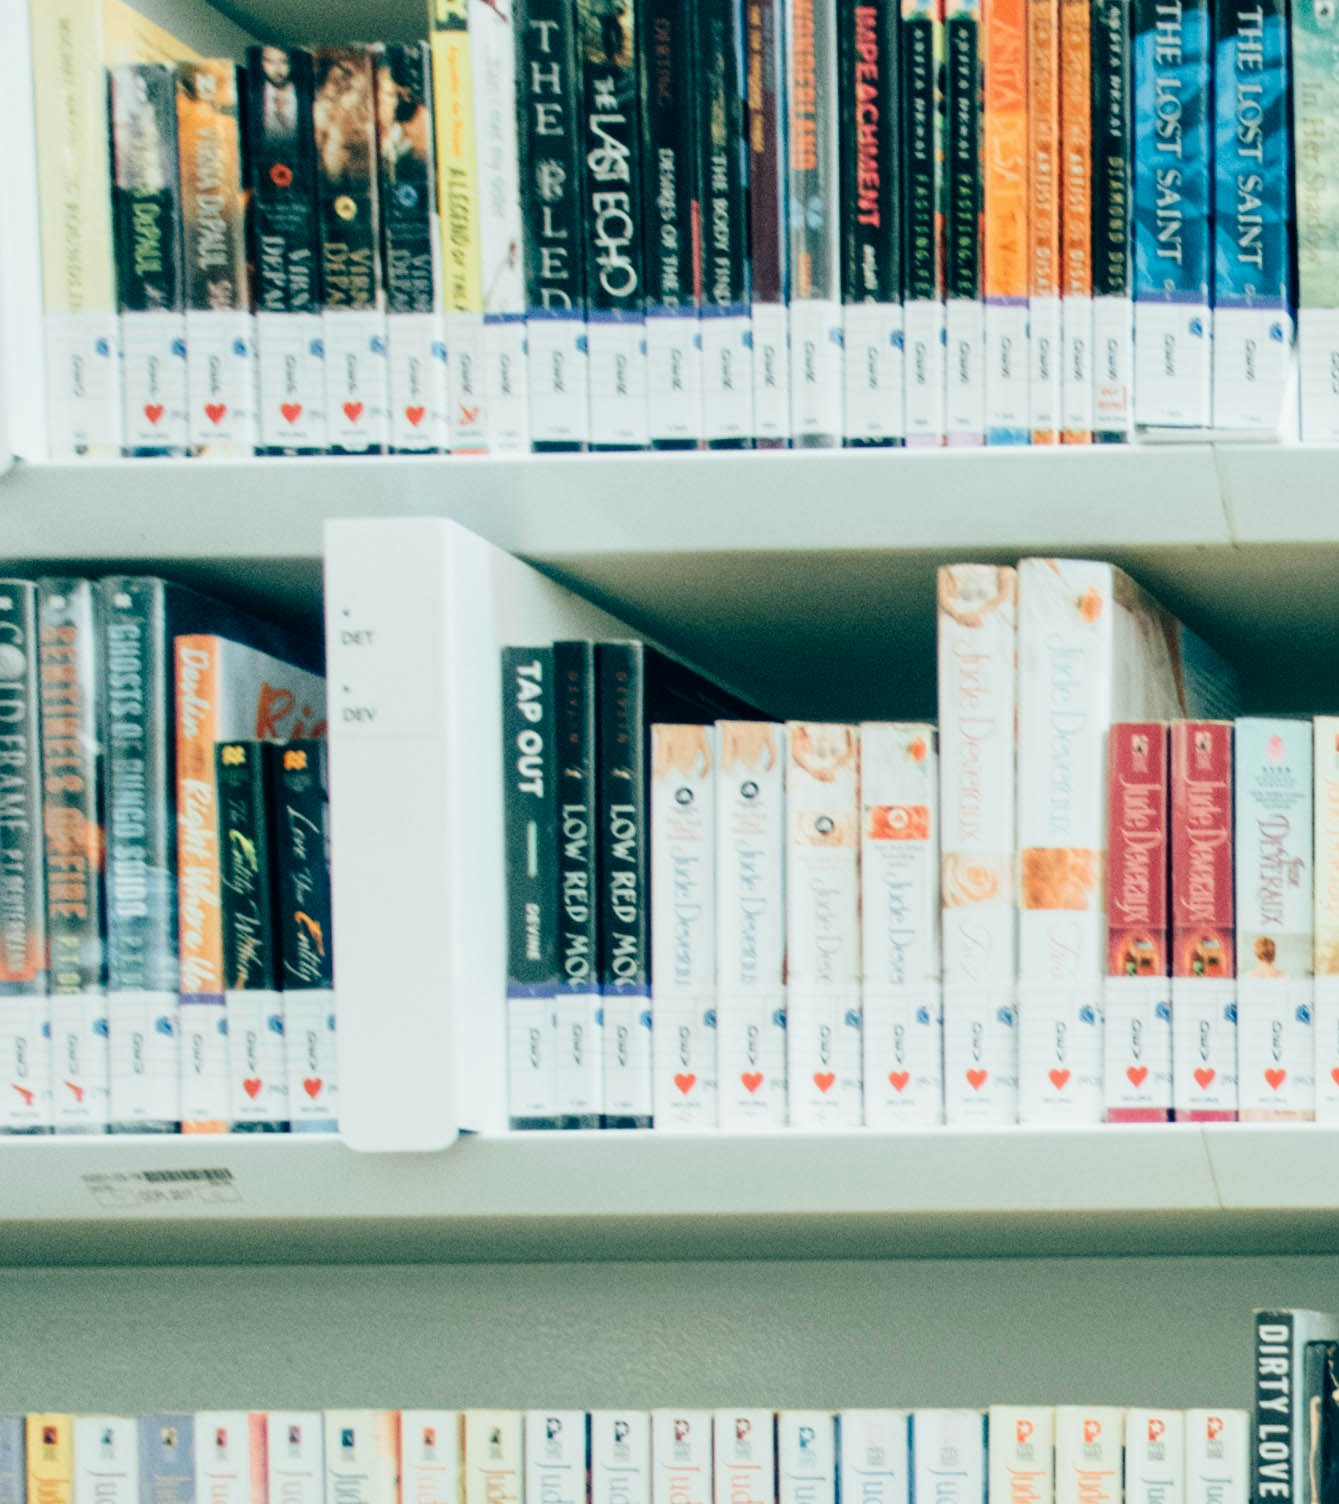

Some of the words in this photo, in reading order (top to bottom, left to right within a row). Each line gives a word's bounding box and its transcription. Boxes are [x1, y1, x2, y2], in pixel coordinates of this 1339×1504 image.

[1155, 1, 1182, 65] THE
[591, 113, 628, 183] LAST
[856, 4, 880, 228] IMPEACHMENT
[1155, 77, 1182, 158] LOST
[591, 190, 638, 299] ECHO
[1155, 170, 1182, 265] SAINT
[517, 660, 542, 723] TAP
[517, 728, 543, 799] OUT
[563, 803, 587, 863] LOW
[563, 870, 587, 924] RED
[1258, 1323, 1289, 1414] DIRTY
[1258, 1423, 1289, 1499] LOVE
